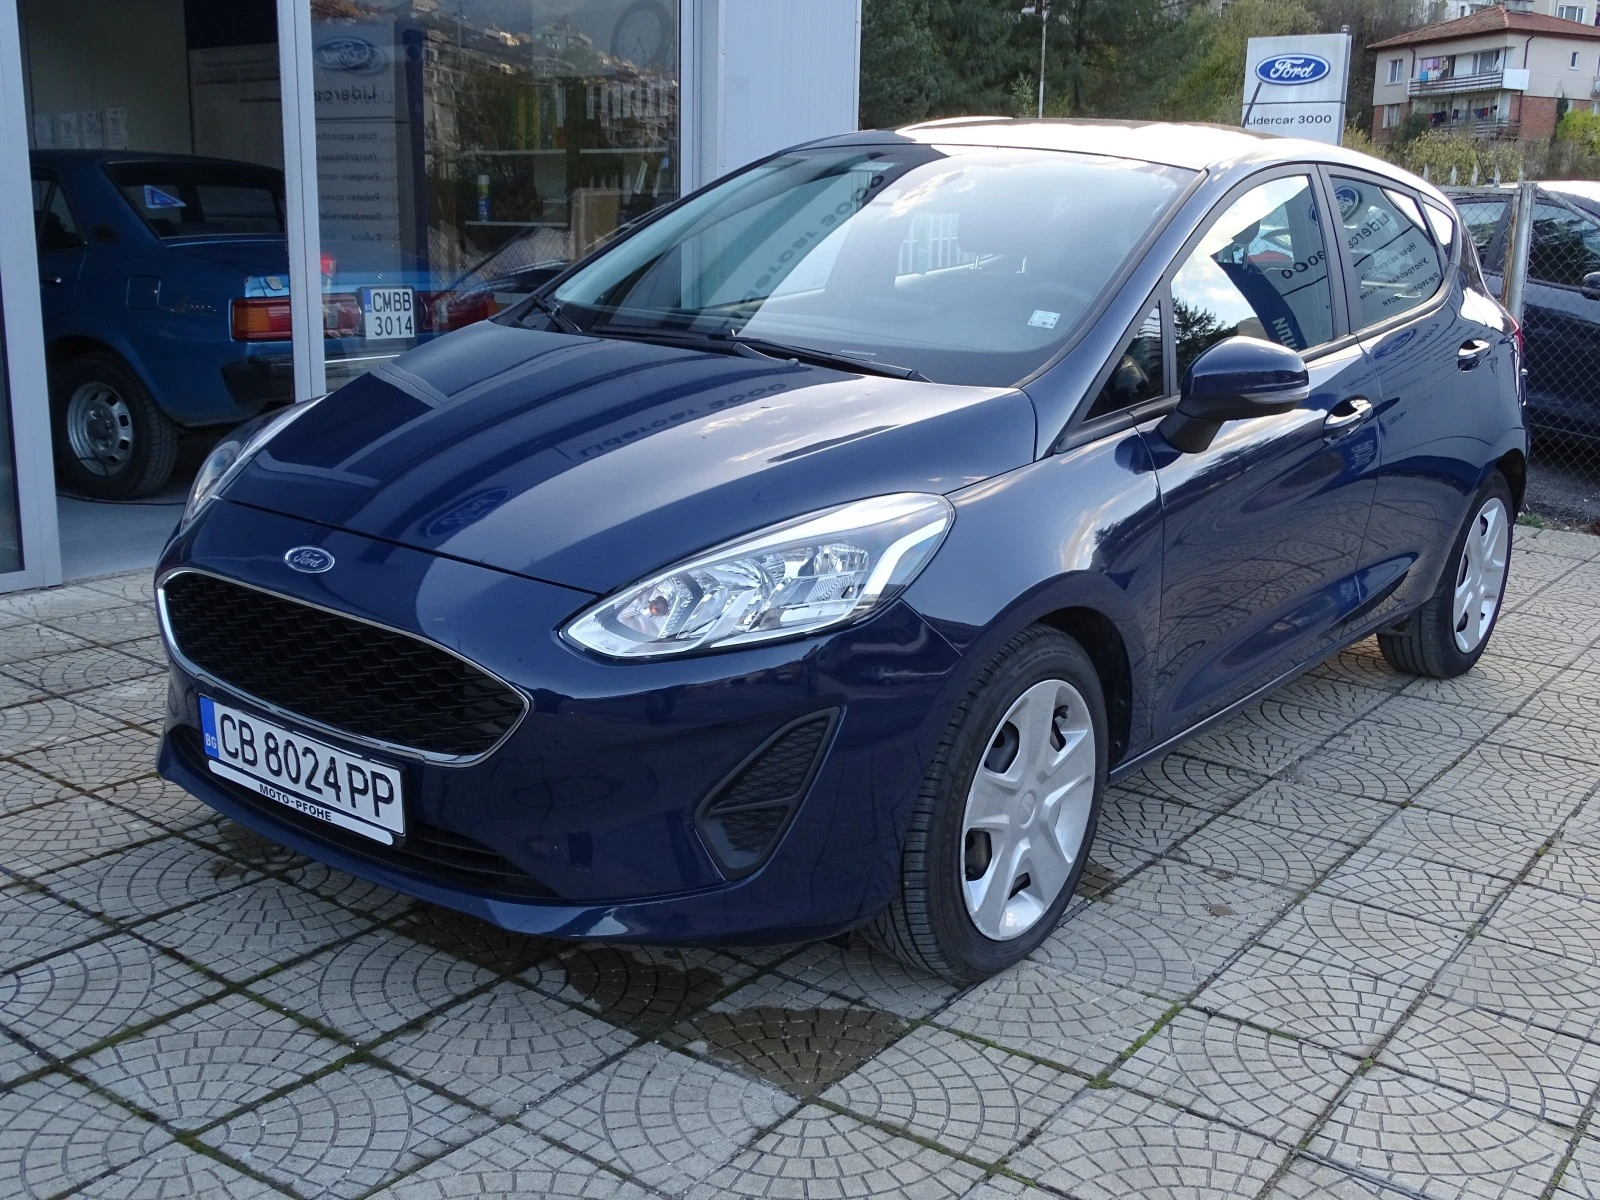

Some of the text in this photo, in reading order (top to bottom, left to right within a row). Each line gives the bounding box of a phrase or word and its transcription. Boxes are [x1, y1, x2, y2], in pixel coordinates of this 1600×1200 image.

[1270, 59, 1315, 78] Ford
[1247, 115, 1332, 125] Lidercar 3000
[373, 292, 411, 312] CMBB
[375, 316, 412, 336] 3014
[205, 732, 217, 750] BG
[259, 783, 332, 822] MOTO-PFOHE
